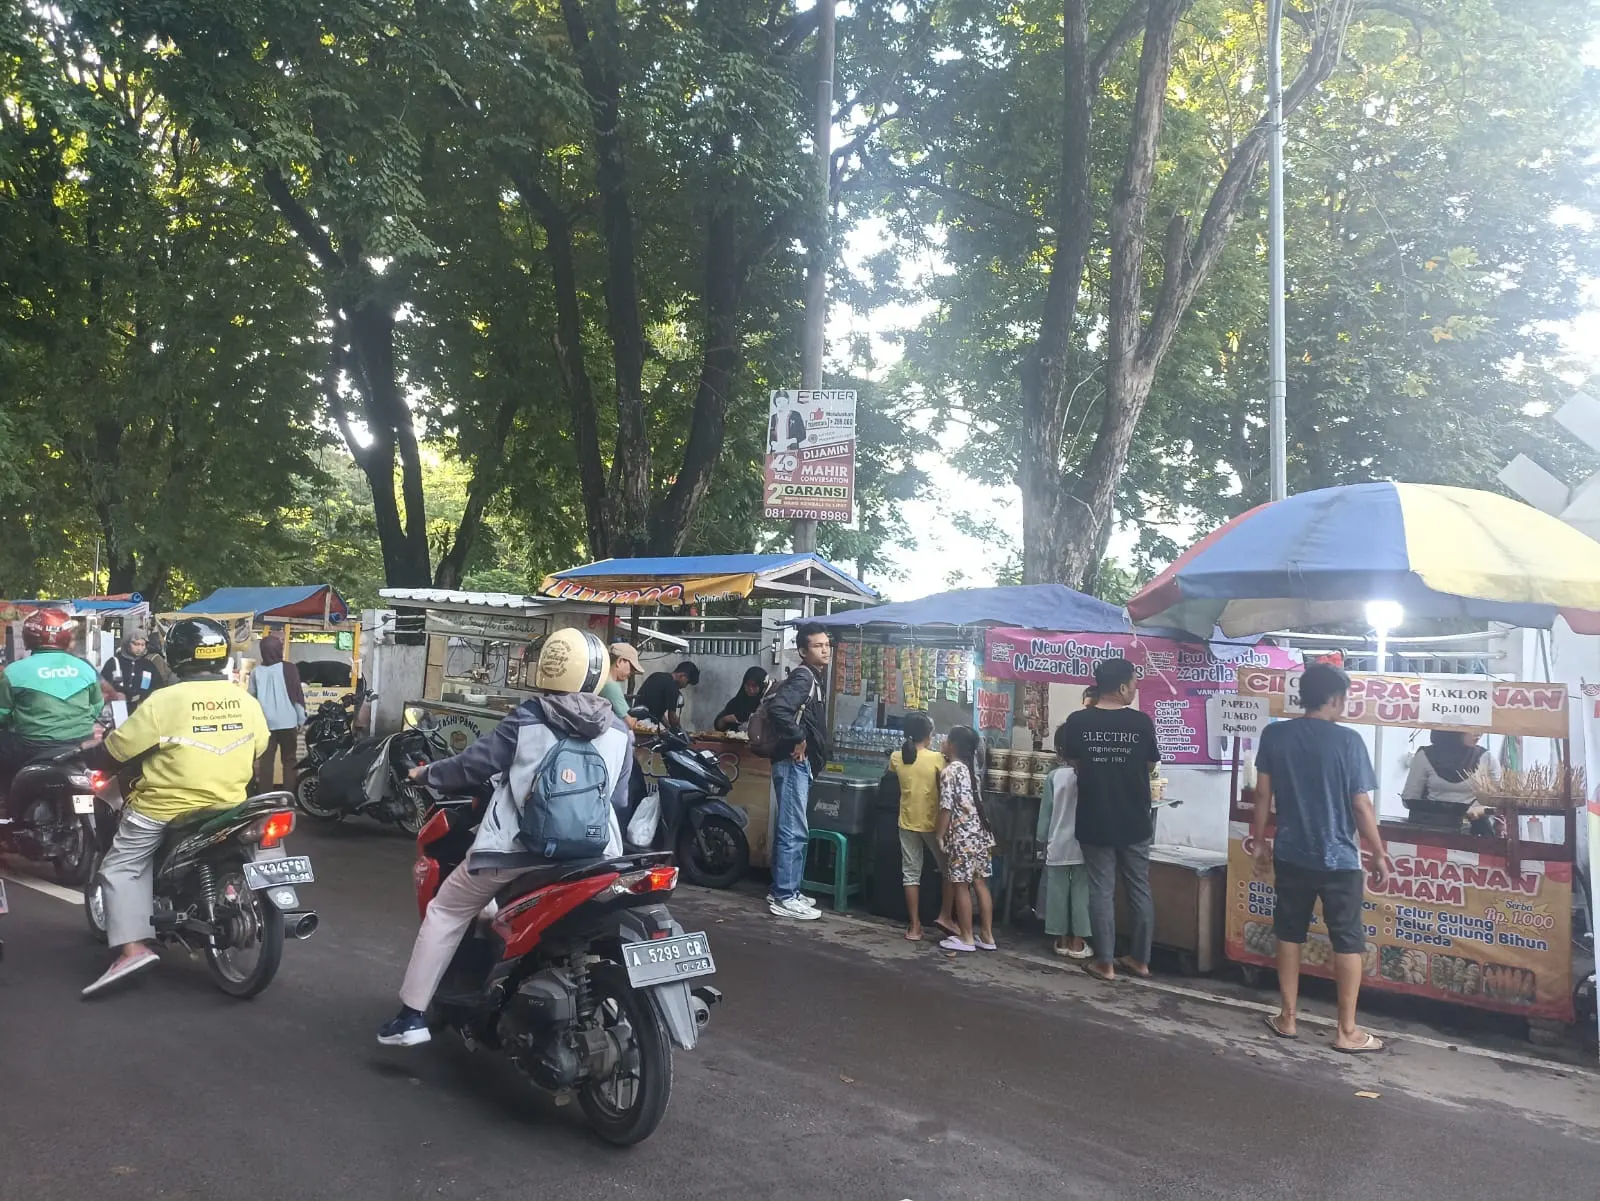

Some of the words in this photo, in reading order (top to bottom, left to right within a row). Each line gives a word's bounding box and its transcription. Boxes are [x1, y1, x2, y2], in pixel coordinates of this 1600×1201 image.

[803, 445, 849, 460] DIJAMIN
[801, 465, 848, 477] MAHIR
[800, 476, 849, 484] CONVERSATION
[767, 483, 783, 504] 2
[784, 486, 847, 498] GARANSI
[765, 508, 785, 518] 081
[790, 509, 817, 519] 7070
[820, 510, 848, 521] 8989
[1031, 639, 1062, 655] New
[1064, 640, 1124, 659] Corndog
[1014, 654, 1088, 676] Mozzarella
[38, 665, 78, 679] Grab
[1425, 688, 1488, 700] MAKLOR
[192, 697, 240, 712] maxim
[1221, 700, 1260, 709] PAPEDA
[1432, 703, 1480, 715] Rp.1000
[1222, 712, 1258, 720] JUMBO
[1223, 724, 1257, 734] Rp.5000
[1082, 732, 1140, 743] ELECTRIC
[1088, 746, 1132, 754] engineering
[250, 866, 258, 877] A
[1249, 882, 1274, 895] Cilo
[1506, 900, 1533, 912] Serba
[1396, 905, 1434, 920] Telur
[1437, 911, 1494, 932] Gulung
[1511, 912, 1554, 929] 1.000
[1396, 916, 1433, 932] Telur
[1437, 924, 1494, 944] Gulung
[1498, 933, 1548, 950] Bihun
[1396, 928, 1452, 948] Papeda
[633, 952, 642, 966] A
[648, 946, 680, 963] 5299
[686, 940, 703, 956] CR
